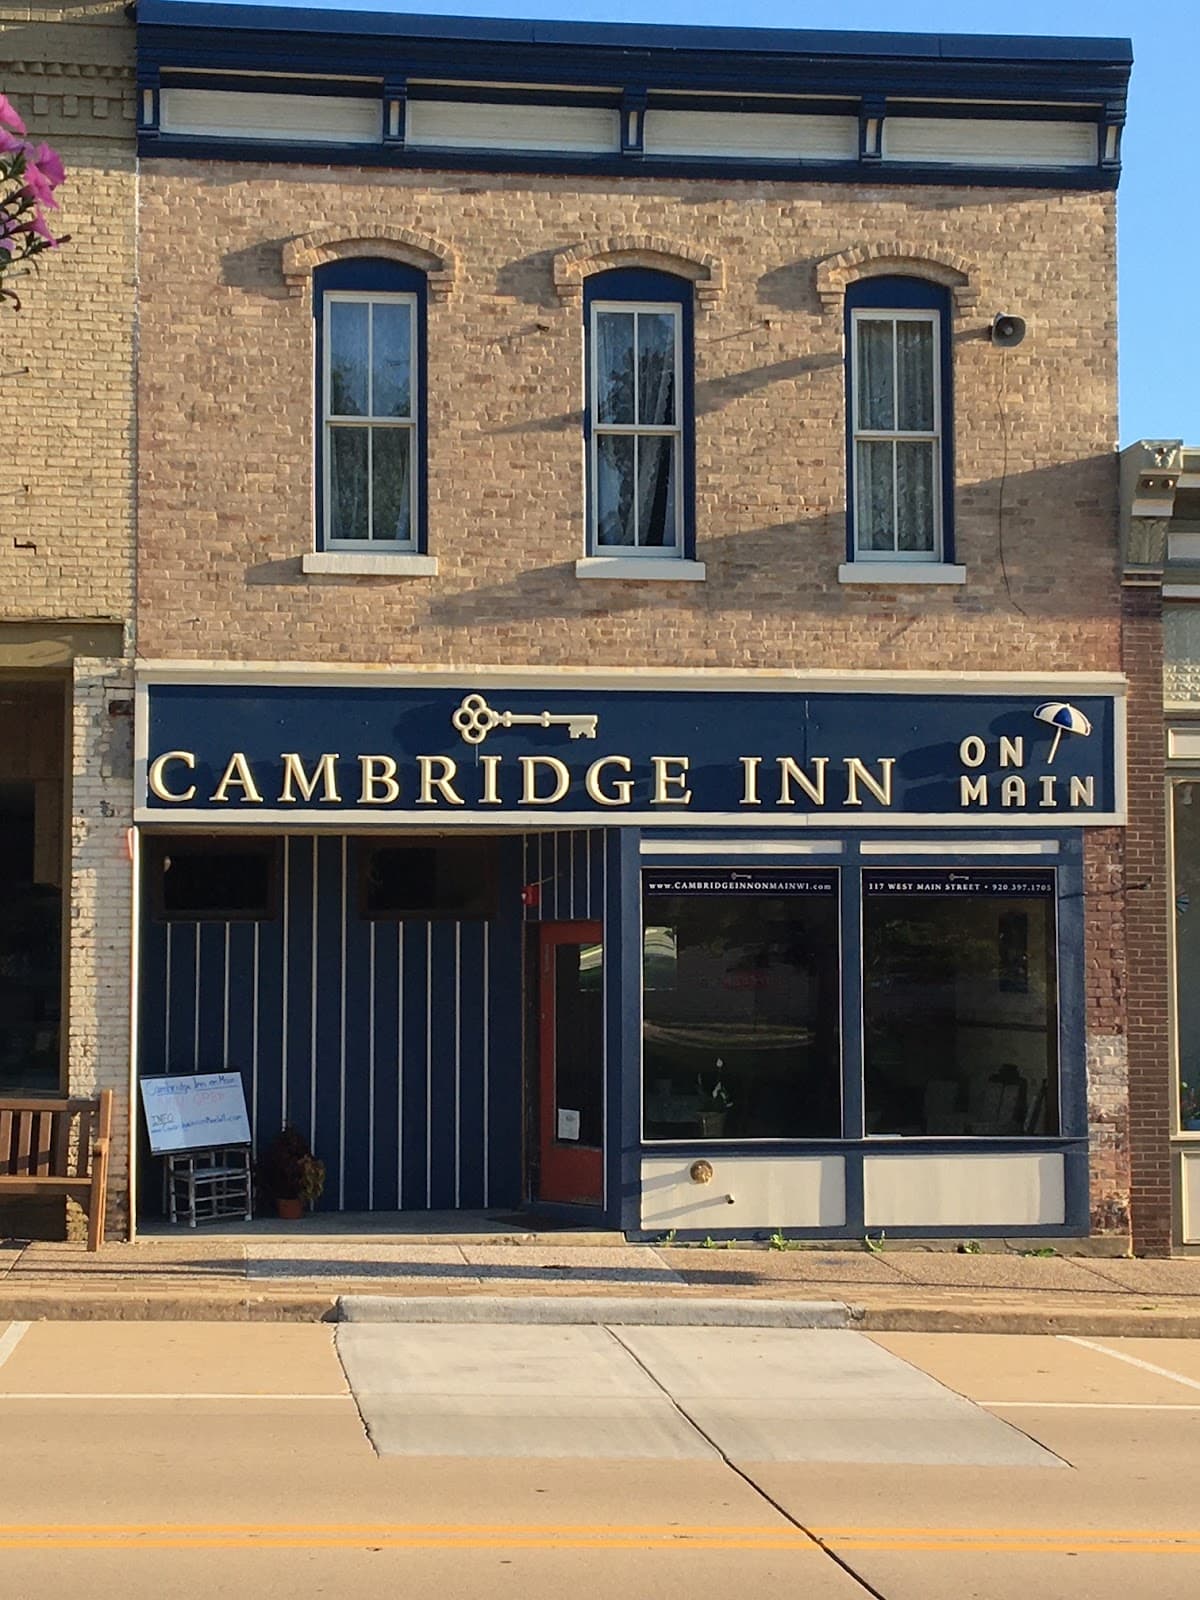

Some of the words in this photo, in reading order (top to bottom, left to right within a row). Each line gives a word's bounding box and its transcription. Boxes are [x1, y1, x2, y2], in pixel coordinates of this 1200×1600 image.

[959, 735, 1024, 767] ON
[149, 749, 692, 805] CAMBRIDGE
[738, 756, 897, 806] INN
[960, 774, 1095, 807] MAIN
[944, 883, 980, 891] STREET
